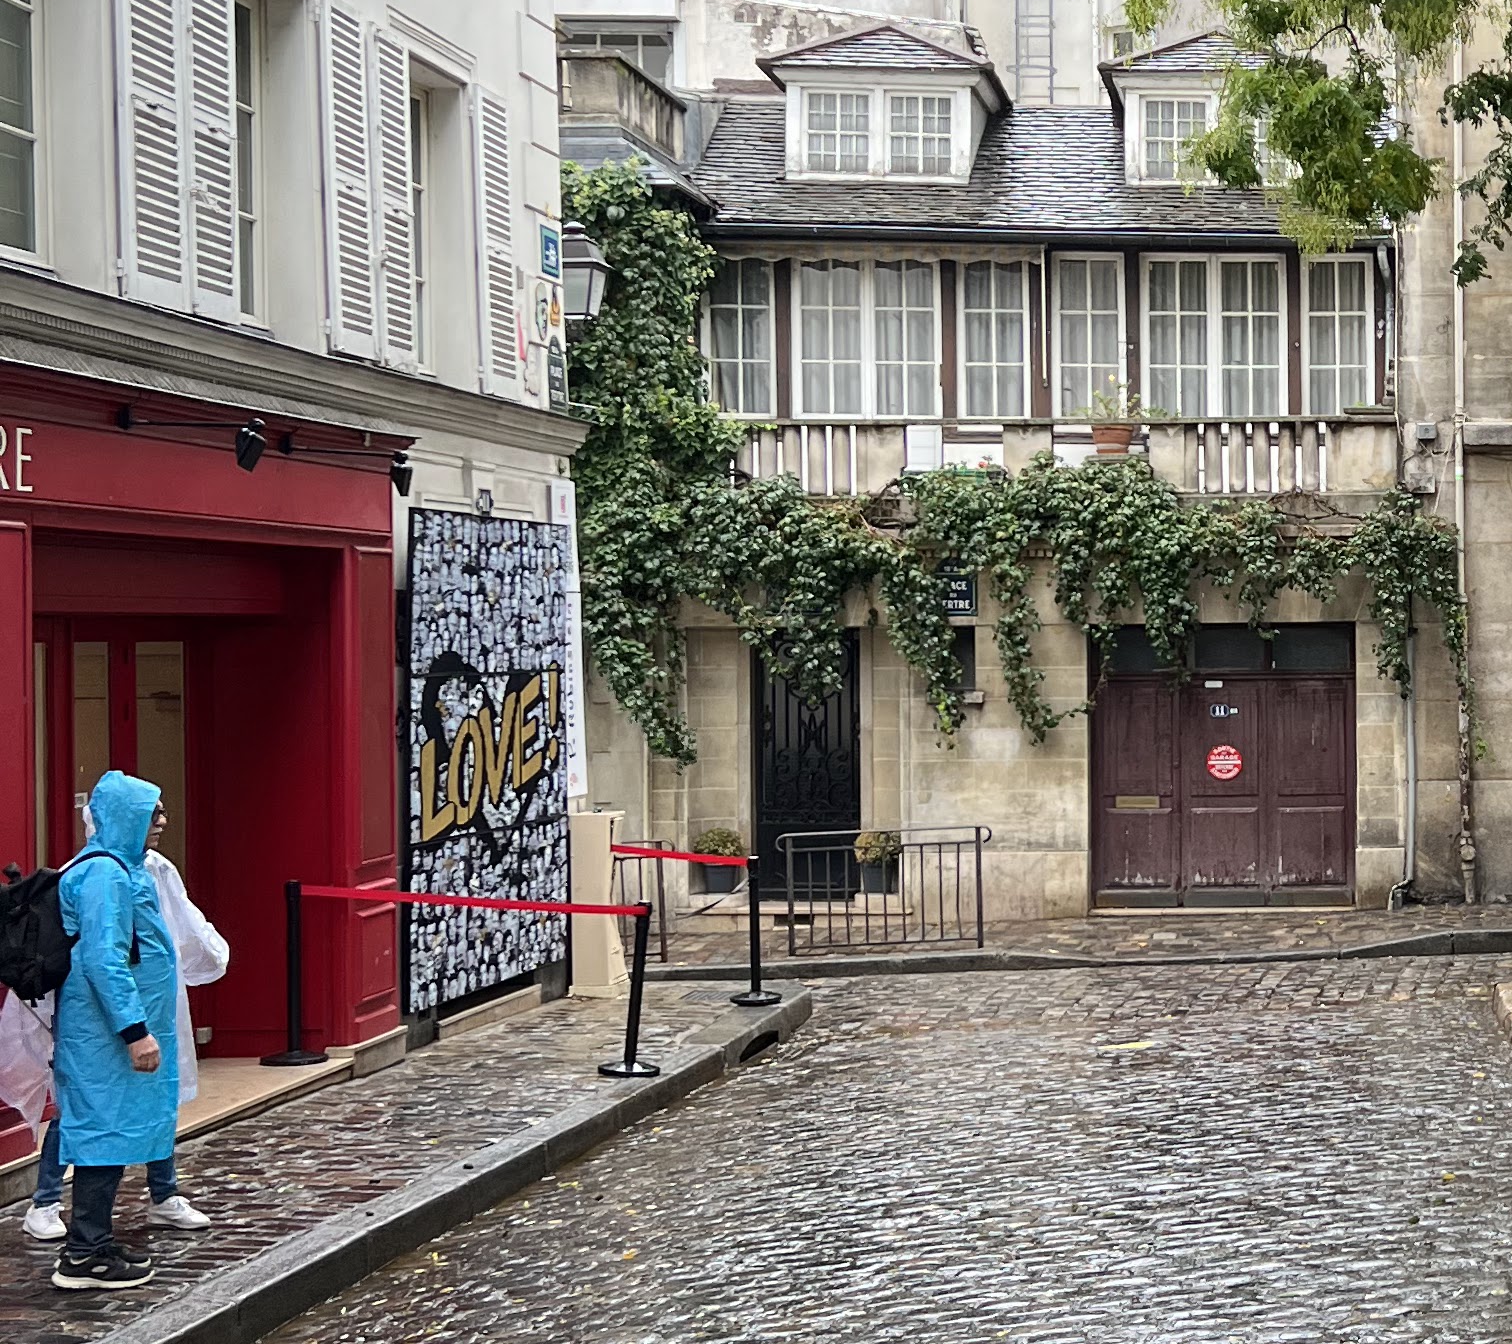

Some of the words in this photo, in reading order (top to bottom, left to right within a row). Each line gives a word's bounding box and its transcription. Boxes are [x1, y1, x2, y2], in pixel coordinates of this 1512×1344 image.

[951, 581, 967, 591] ACE
[942, 600, 970, 609] ERTRE
[1215, 705, 1225, 716] 11
[421, 662, 559, 842] LOVE!
